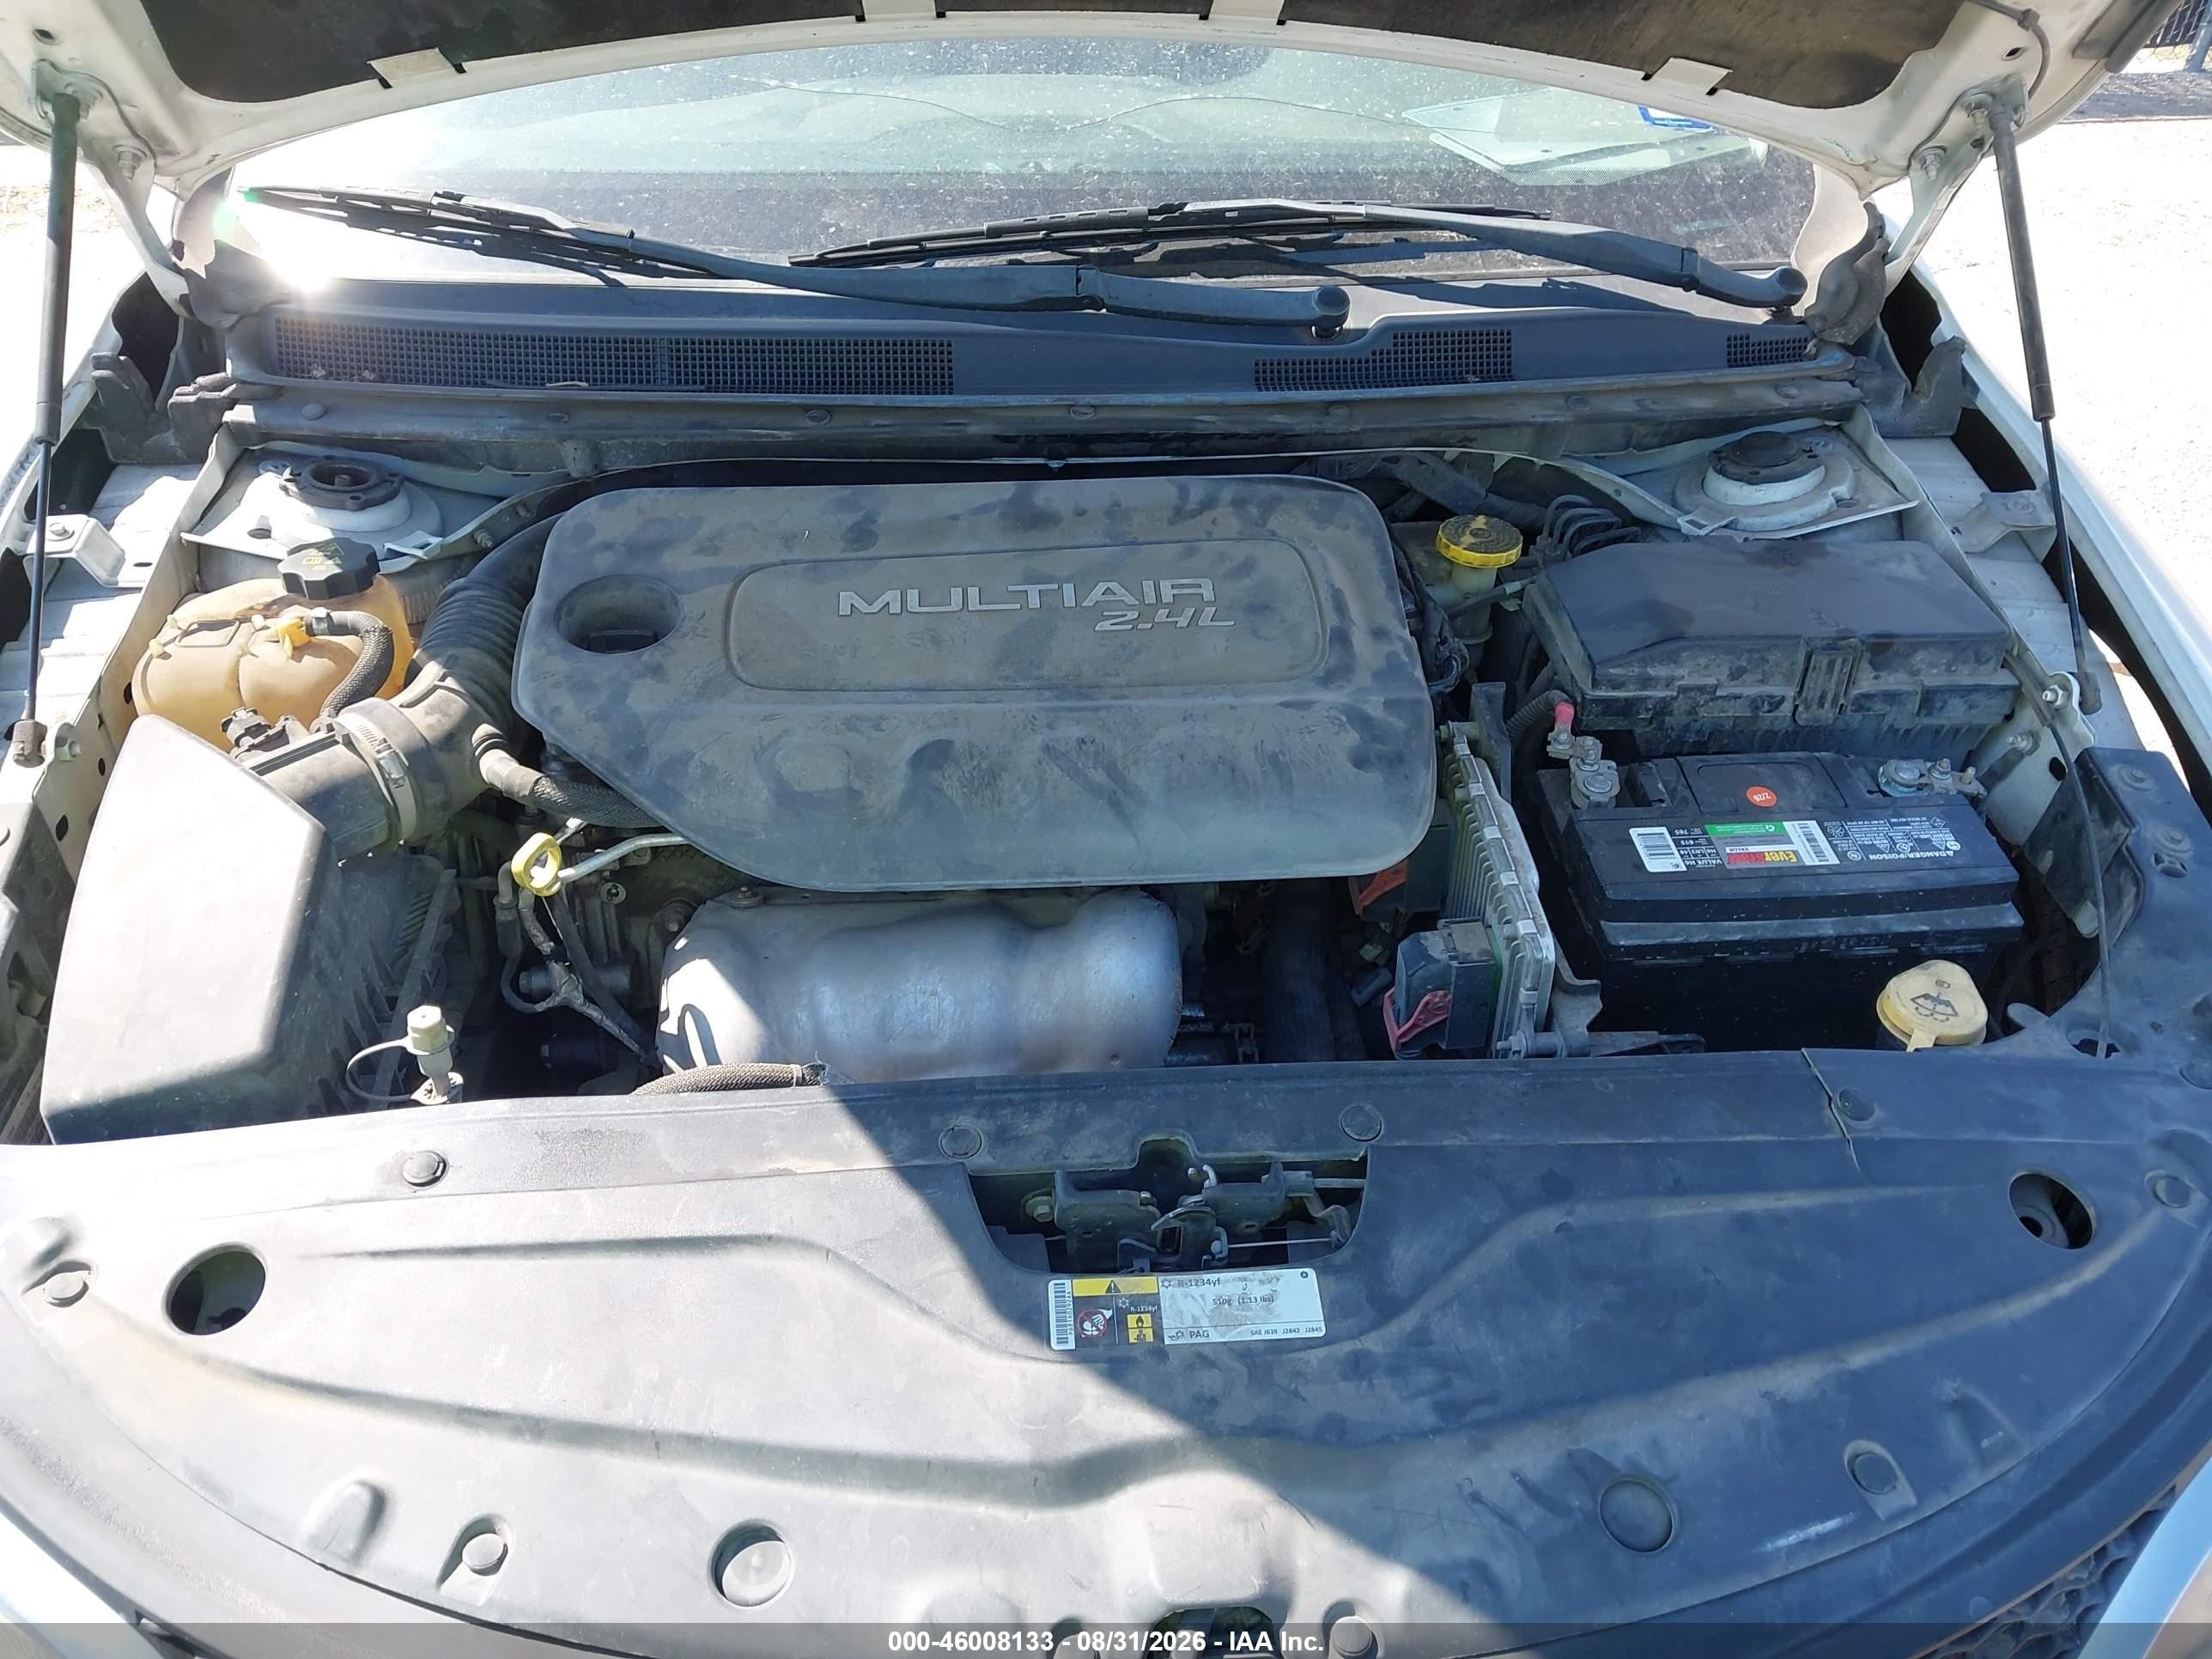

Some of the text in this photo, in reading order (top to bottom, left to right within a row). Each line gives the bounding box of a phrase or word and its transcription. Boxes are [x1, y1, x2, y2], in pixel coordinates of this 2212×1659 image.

[837, 577, 1217, 617] MULTIAIR
[1094, 606, 1236, 633] 2.4L
[1869, 851, 1946, 860] DANGER/POISON
[1177, 1277, 1221, 1288] R-1234yf
[1130, 1304, 1158, 1314] R-1234yf
[1189, 1330, 1210, 1339] PAG
